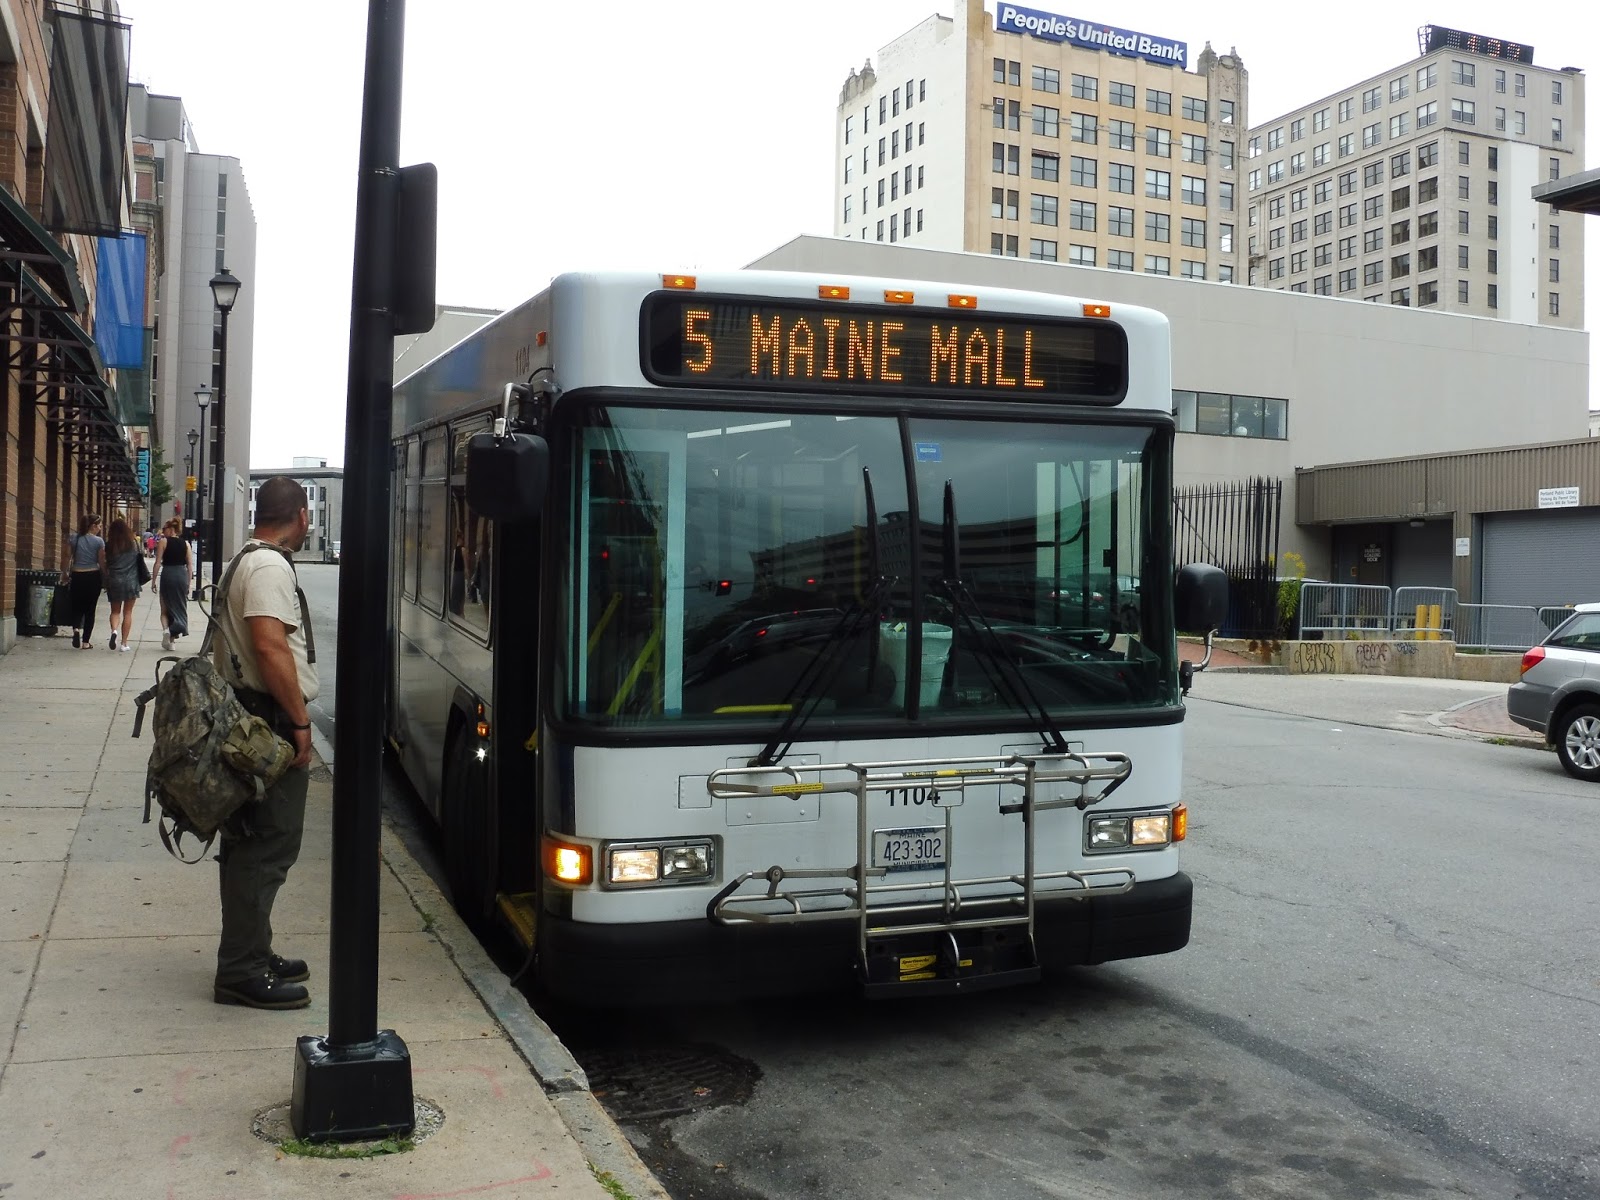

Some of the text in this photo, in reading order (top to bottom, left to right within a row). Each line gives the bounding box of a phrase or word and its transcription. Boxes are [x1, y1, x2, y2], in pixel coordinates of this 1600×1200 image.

[1002, 7, 1185, 62] People's United Bank
[516, 345, 530, 377] 1104
[686, 310, 1044, 387] 5 MAINE MALL
[886, 787, 941, 807] 1104
